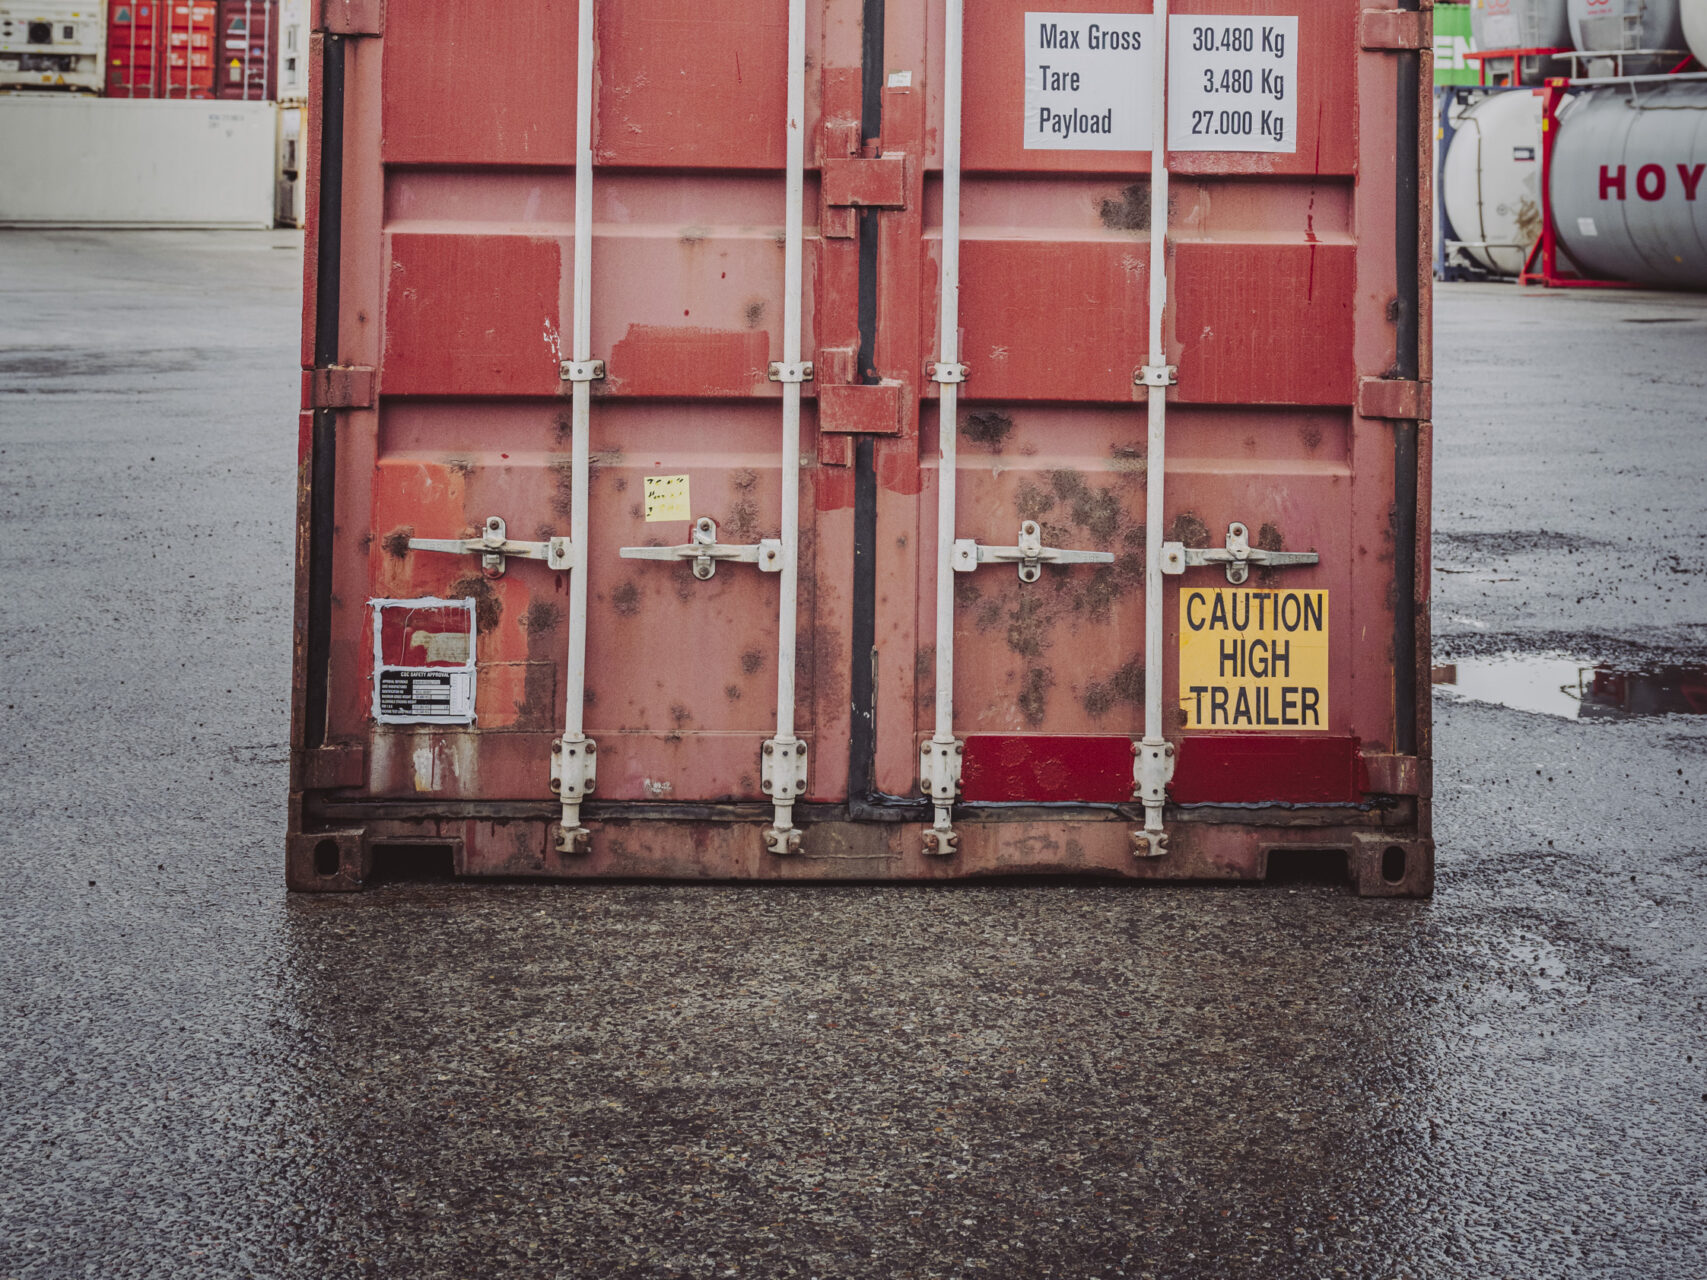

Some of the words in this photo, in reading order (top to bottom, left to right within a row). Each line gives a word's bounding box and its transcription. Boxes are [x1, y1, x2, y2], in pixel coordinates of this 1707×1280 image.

[1039, 23, 1080, 50] Max
[1088, 23, 1142, 51] Gross
[1192, 26, 1254, 52] 30.480
[1261, 26, 1285, 58] Kg
[1039, 65, 1080, 92] Tare
[1203, 68, 1253, 94] 3.480
[1261, 68, 1284, 100] Kg
[1039, 107, 1112, 139] Payload
[1191, 110, 1253, 135] 27.000
[1261, 110, 1284, 142] Kg
[1598, 162, 1707, 202] HOY
[1186, 591, 1323, 632] CAUTION
[1219, 638, 1290, 679] HIGH
[1189, 685, 1320, 726] TRAILER
